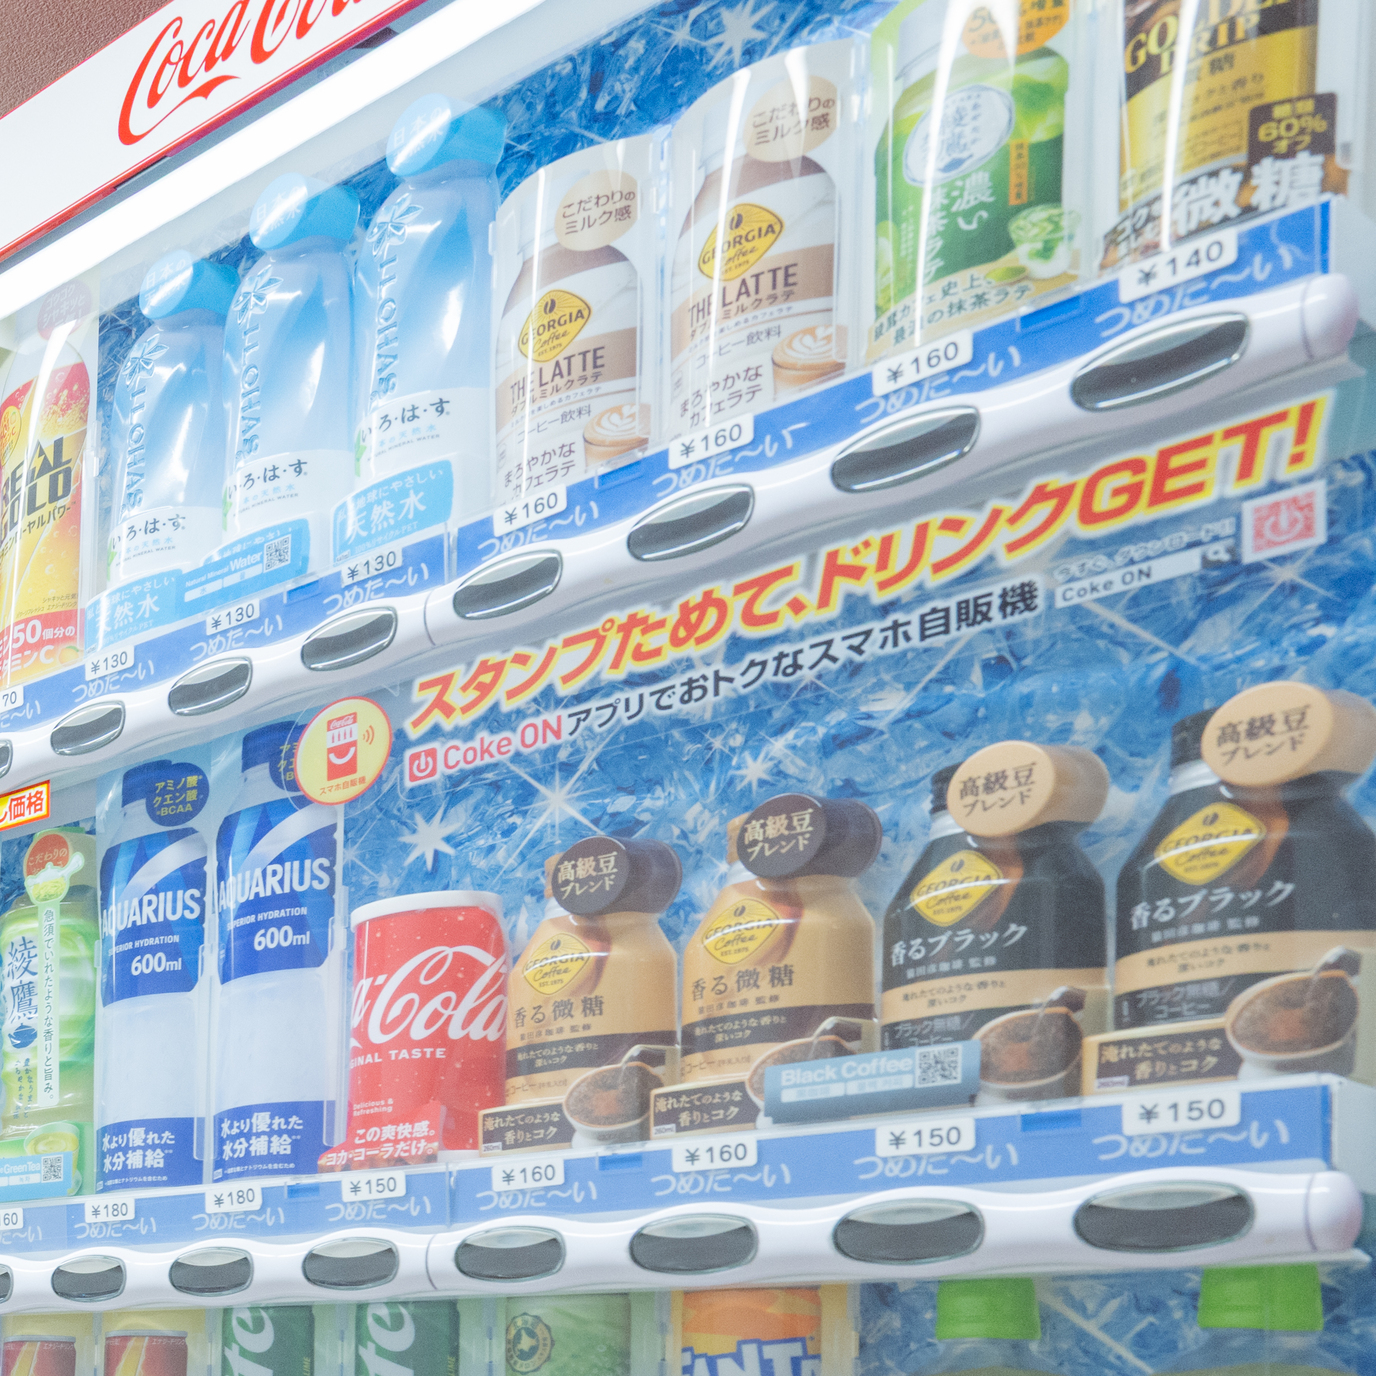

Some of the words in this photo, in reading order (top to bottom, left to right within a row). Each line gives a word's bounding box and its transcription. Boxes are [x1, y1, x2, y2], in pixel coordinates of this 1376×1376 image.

[1256, 111, 1328, 143] 60%
[561, 188, 636, 220] こだわりの
[951, 172, 995, 232] 濃い
[564, 204, 633, 236] ミルク感
[1136, 240, 1224, 288] ¥140
[721, 262, 799, 309] LATTE
[695, 325, 782, 370] コーヒー飲料
[885, 341, 960, 384] ¥160
[537, 345, 606, 388] LATTE
[517, 404, 592, 444] コーヒー飲料
[678, 423, 743, 460] ¥160
[503, 492, 559, 526] ¥160
[229, 549, 263, 574] Water
[346, 550, 398, 582] ¥130
[408, 399, 1322, 731] スタンプためて、ドリンクGET!
[1061, 579, 1114, 603] Coke
[1120, 566, 1153, 588] ON
[210, 603, 256, 631] ¥130
[90, 650, 131, 676] ¥130
[442, 732, 513, 774] Coke
[518, 713, 563, 751] ON
[565, 581, 1040, 735] アプリでおトクなスマホ自販機
[1216, 704, 1310, 749] 高級豆
[1220, 732, 1305, 766] ブレンド
[154, 774, 198, 794] アミノ酸
[319, 775, 368, 797] スマホ自販機
[958, 761, 1037, 801] 高級豆
[152, 788, 198, 809] クエン酸
[160, 802, 193, 817] BCAA
[962, 789, 1033, 818] ブレンド
[743, 808, 815, 846] 高級豆
[746, 836, 810, 862] ブレンド
[557, 850, 619, 883] 高級豆
[218, 856, 331, 912] AQUARIUS
[560, 876, 617, 900] ブレンド
[101, 888, 202, 939] AQUARIUS
[1129, 879, 1296, 931] 香るブラック
[133, 934, 180, 949] HYDRATION
[253, 924, 311, 952] 600ml
[890, 923, 1028, 967] 香るブラック
[6, 935, 39, 1024] 綾鷹
[130, 952, 182, 977] 600ml
[690, 963, 795, 1003] 香る微糖
[42, 908, 56, 1100] 急須でいれたような香りと旨み。
[514, 994, 606, 1030] 香る微糖
[388, 1047, 447, 1061] TASTE
[780, 1065, 839, 1087] Black
[841, 1054, 915, 1080] Coffee
[220, 1111, 304, 1141] 水より優れた
[1138, 1099, 1226, 1125] ¥150
[353, 1119, 436, 1143] この爽快感。
[887, 1125, 962, 1151] ¥150
[684, 1143, 748, 1165] ¥160
[501, 1164, 557, 1185] ¥160
[213, 1187, 256, 1208] ¥180
